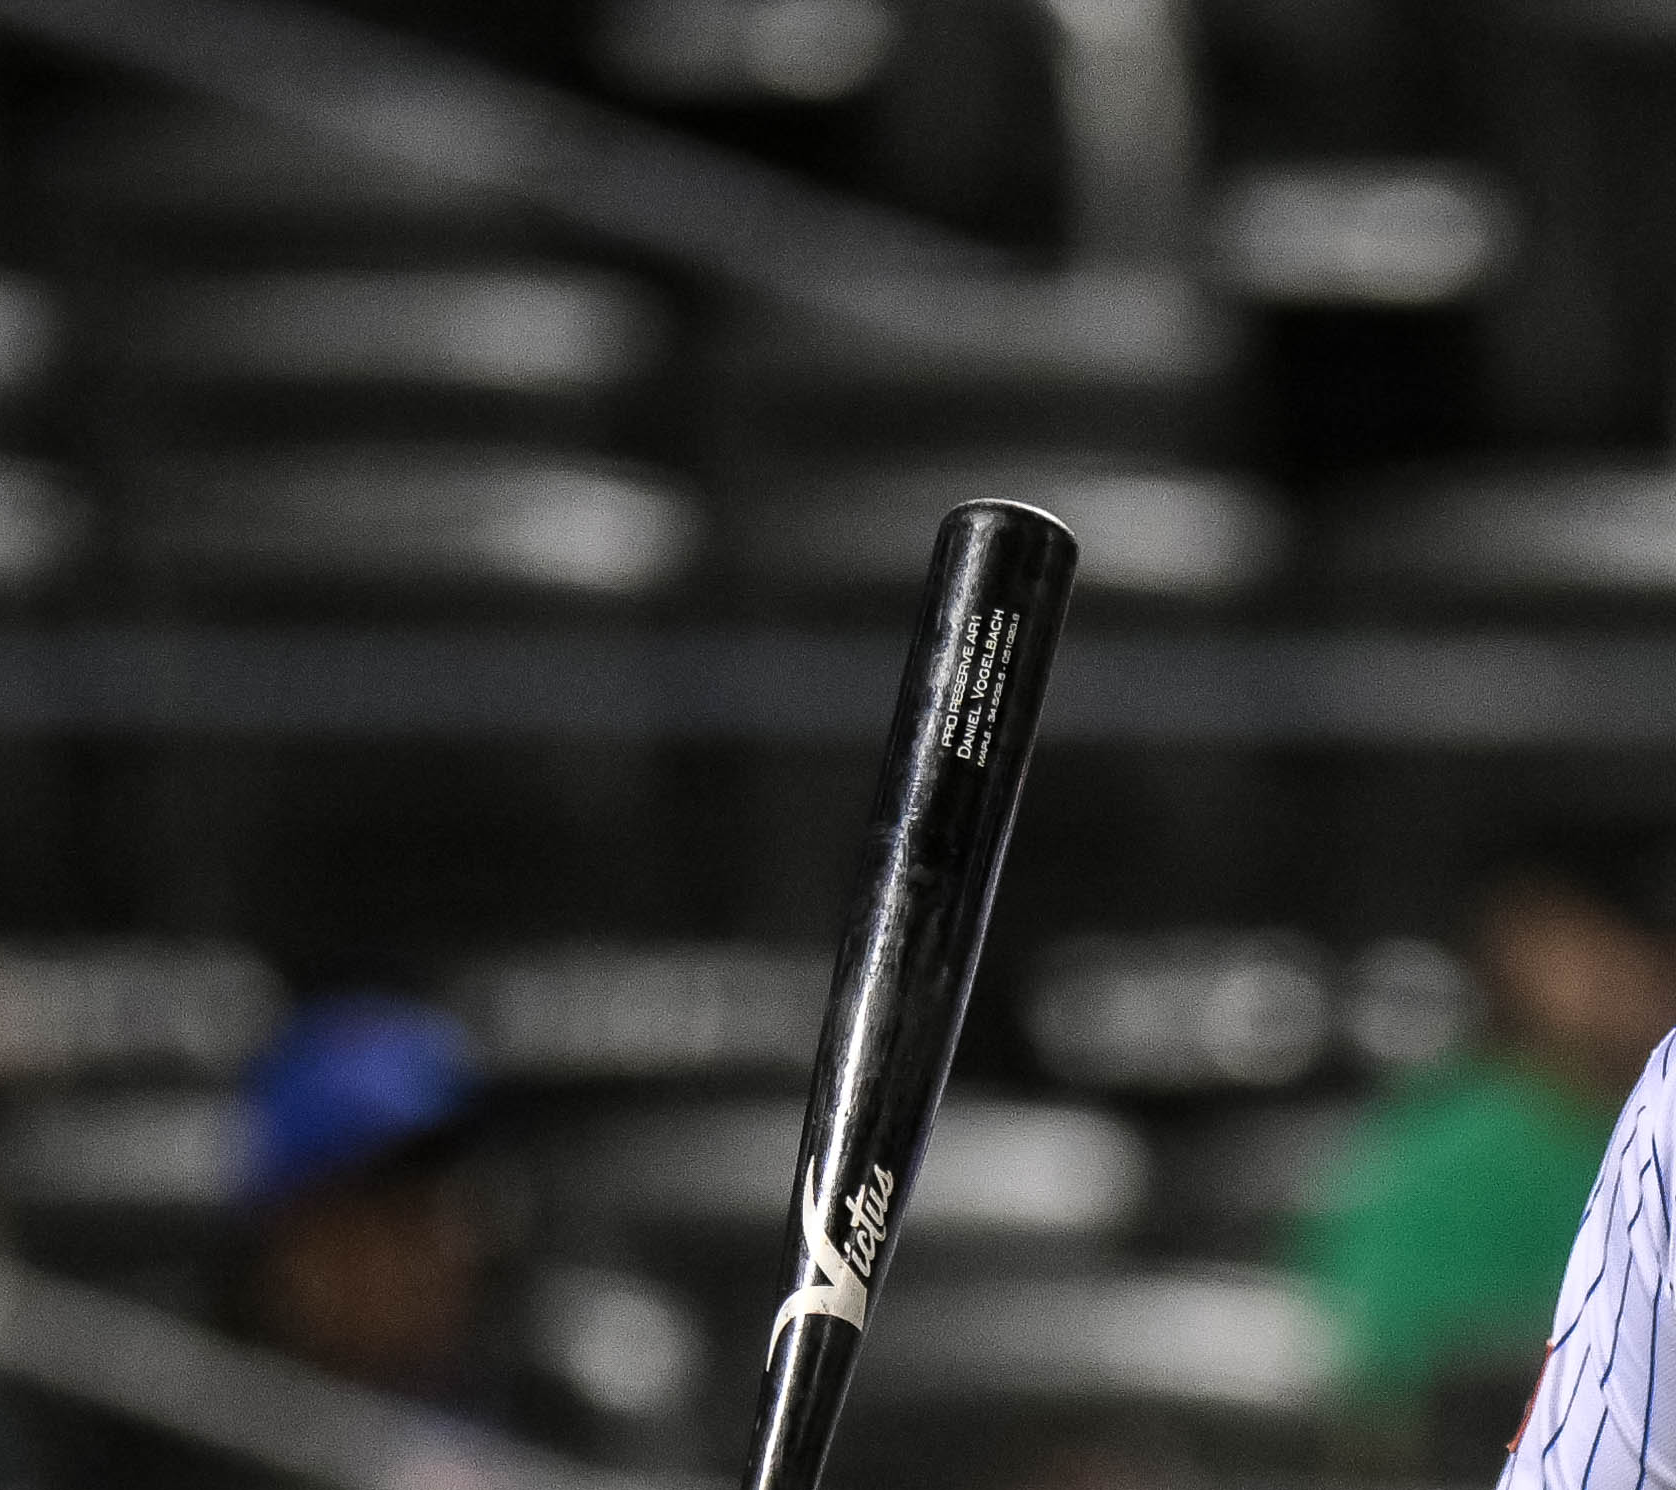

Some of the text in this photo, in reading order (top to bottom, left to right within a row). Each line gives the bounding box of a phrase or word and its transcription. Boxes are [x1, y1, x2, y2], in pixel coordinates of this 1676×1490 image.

[941, 614, 983, 747] PRO RESERVE AR1
[766, 1154, 894, 1373] Victus
